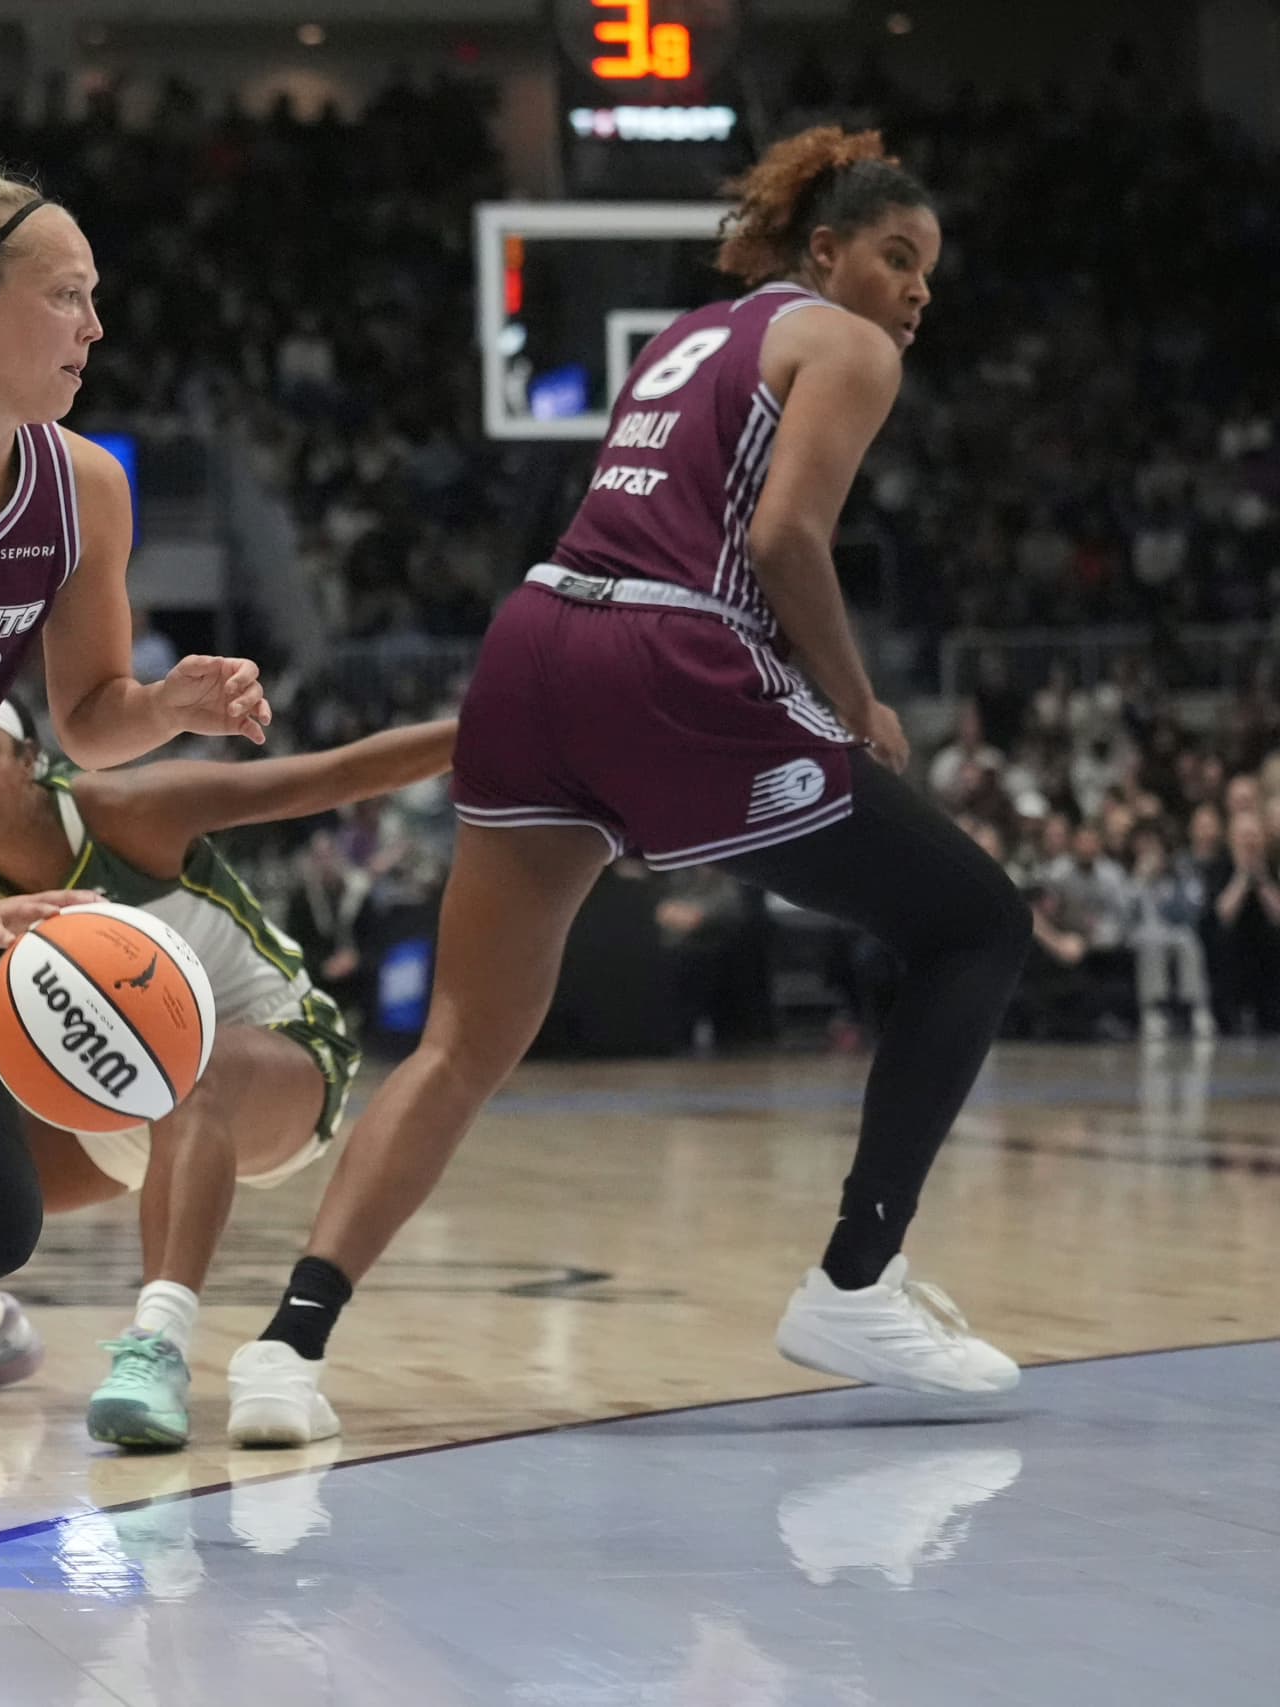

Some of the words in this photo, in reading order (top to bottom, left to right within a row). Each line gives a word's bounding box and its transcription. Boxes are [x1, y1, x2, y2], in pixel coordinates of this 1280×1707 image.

[632, 326, 731, 401] 8
[593, 466, 669, 496] AT&T
[0, 545, 56, 560] SEPHORA
[31, 960, 139, 1100] Wilson
